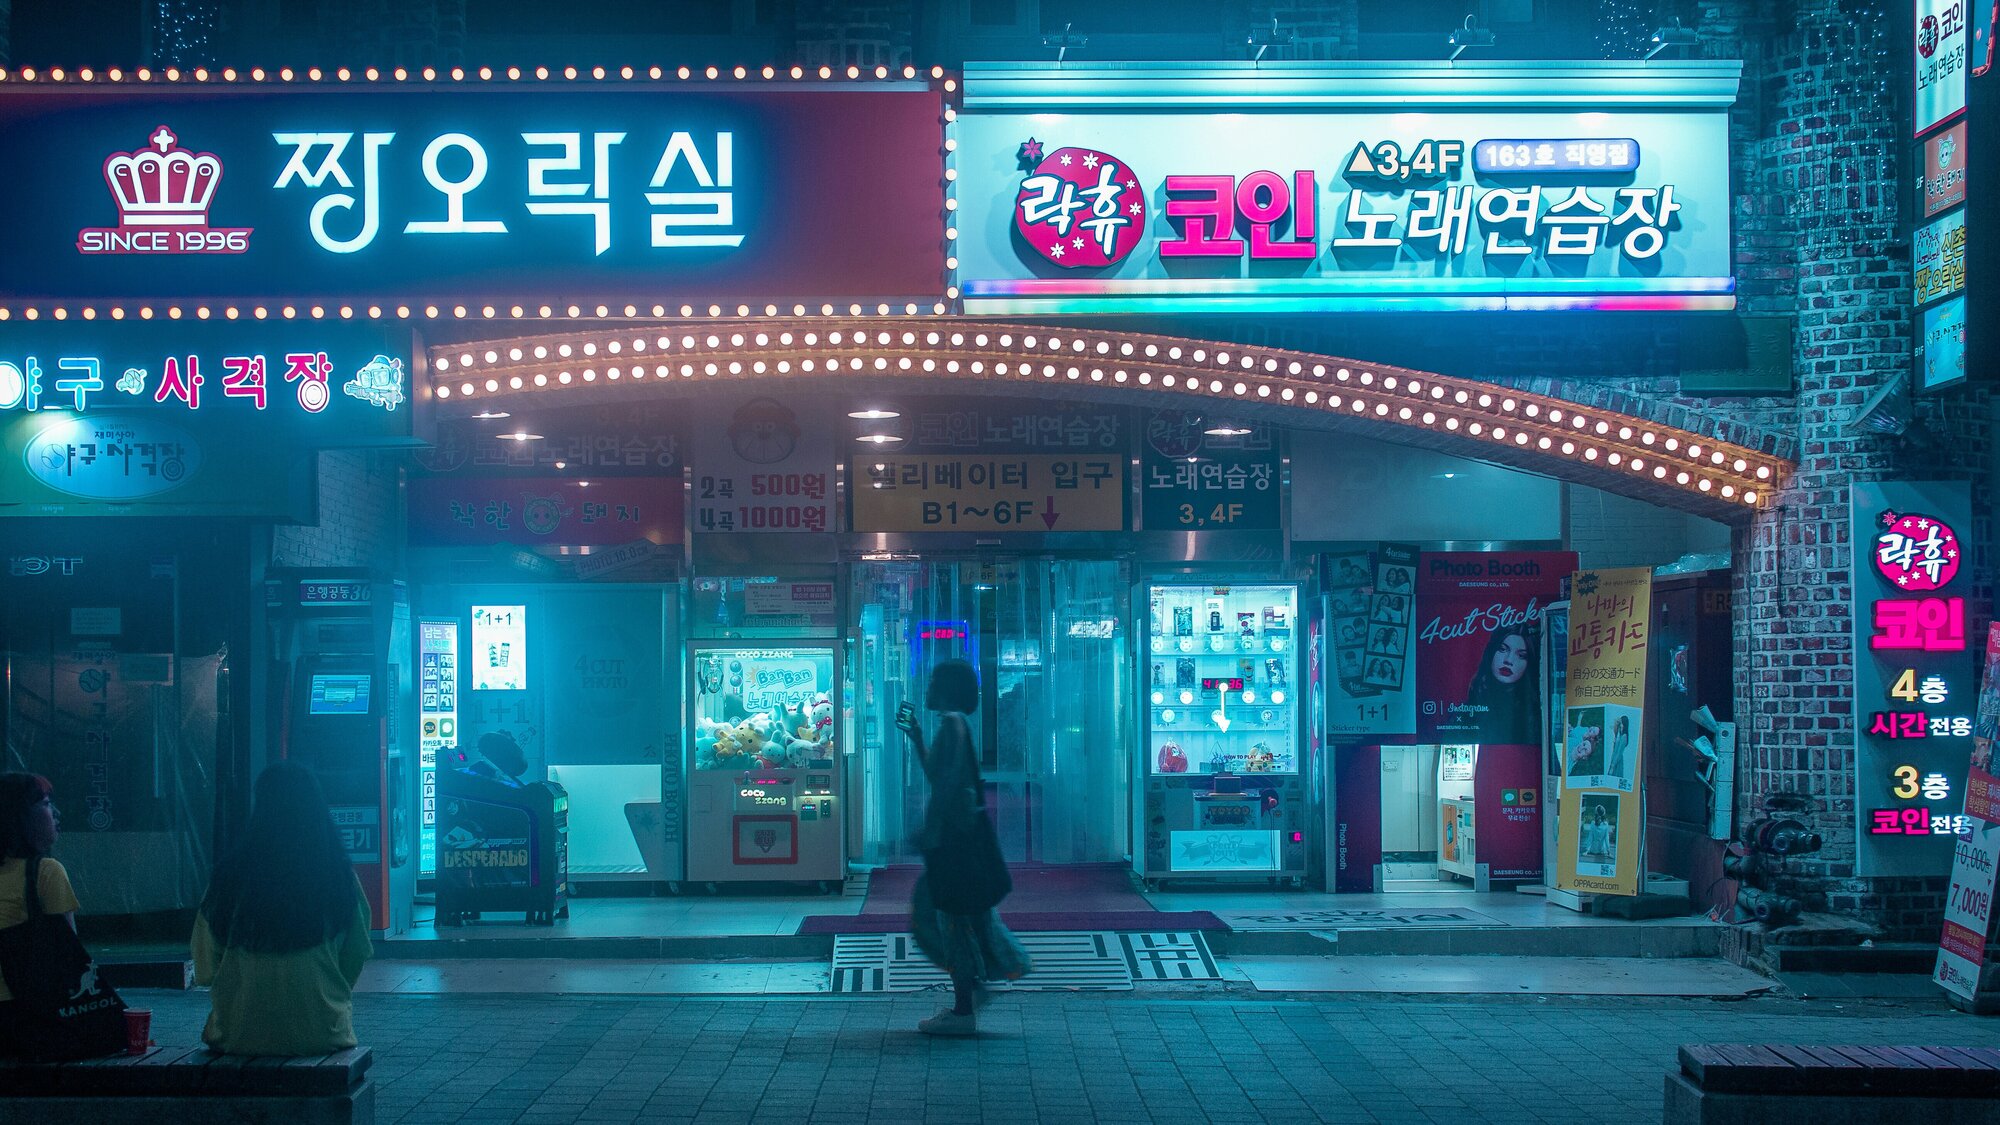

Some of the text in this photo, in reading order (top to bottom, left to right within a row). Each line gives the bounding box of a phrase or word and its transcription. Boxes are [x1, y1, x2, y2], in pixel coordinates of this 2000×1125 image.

[1941, 0, 1963, 41] 코인
[1918, 44, 1964, 90] 노래연습장
[1486, 145, 1630, 167] 163호 직영점
[1020, 164, 1682, 258] 락휴 코인 노래연습장
[82, 231, 248, 252] SINCE 1996
[1942, 226, 1966, 263] 신촌
[919, 410, 980, 445] 코인
[983, 413, 1121, 447] 노래연습장
[539, 434, 678, 467] 노래연습장
[700, 473, 826, 500] 2곡 500원
[867, 462, 1114, 490] 엘리베이터 입구
[1149, 463, 1273, 491] 노래연습장
[581, 501, 640, 524] 돼지
[700, 505, 826, 532] 4곡 1000원
[922, 501, 1033, 525] B1~6F
[1430, 560, 1541, 577] Photo Booth
[1877, 530, 1949, 584] 락휴
[306, 585, 350, 600] 은행공동
[1587, 594, 1634, 618] 나만의
[485, 612, 512, 626] 1+1
[1420, 608, 1485, 644] 4cut
[1873, 598, 1966, 649] 코인
[1570, 620, 1645, 660] 교통카드
[762, 651, 794, 659] ZZANG
[1573, 667, 1641, 680] 自分の交通カード
[1892, 669, 1948, 704] 4층
[1574, 685, 1638, 698] 你自己的交通卡
[1356, 703, 1389, 722] 1+1
[1448, 703, 1490, 717] Instagram
[1894, 766, 1950, 800] 3층
[1339, 823, 1348, 871] Photo Booth
[1573, 878, 1620, 891] OPPAcard.com
[1951, 883, 1990, 921] 7,000원
[58, 998, 118, 1018] KANGOL
